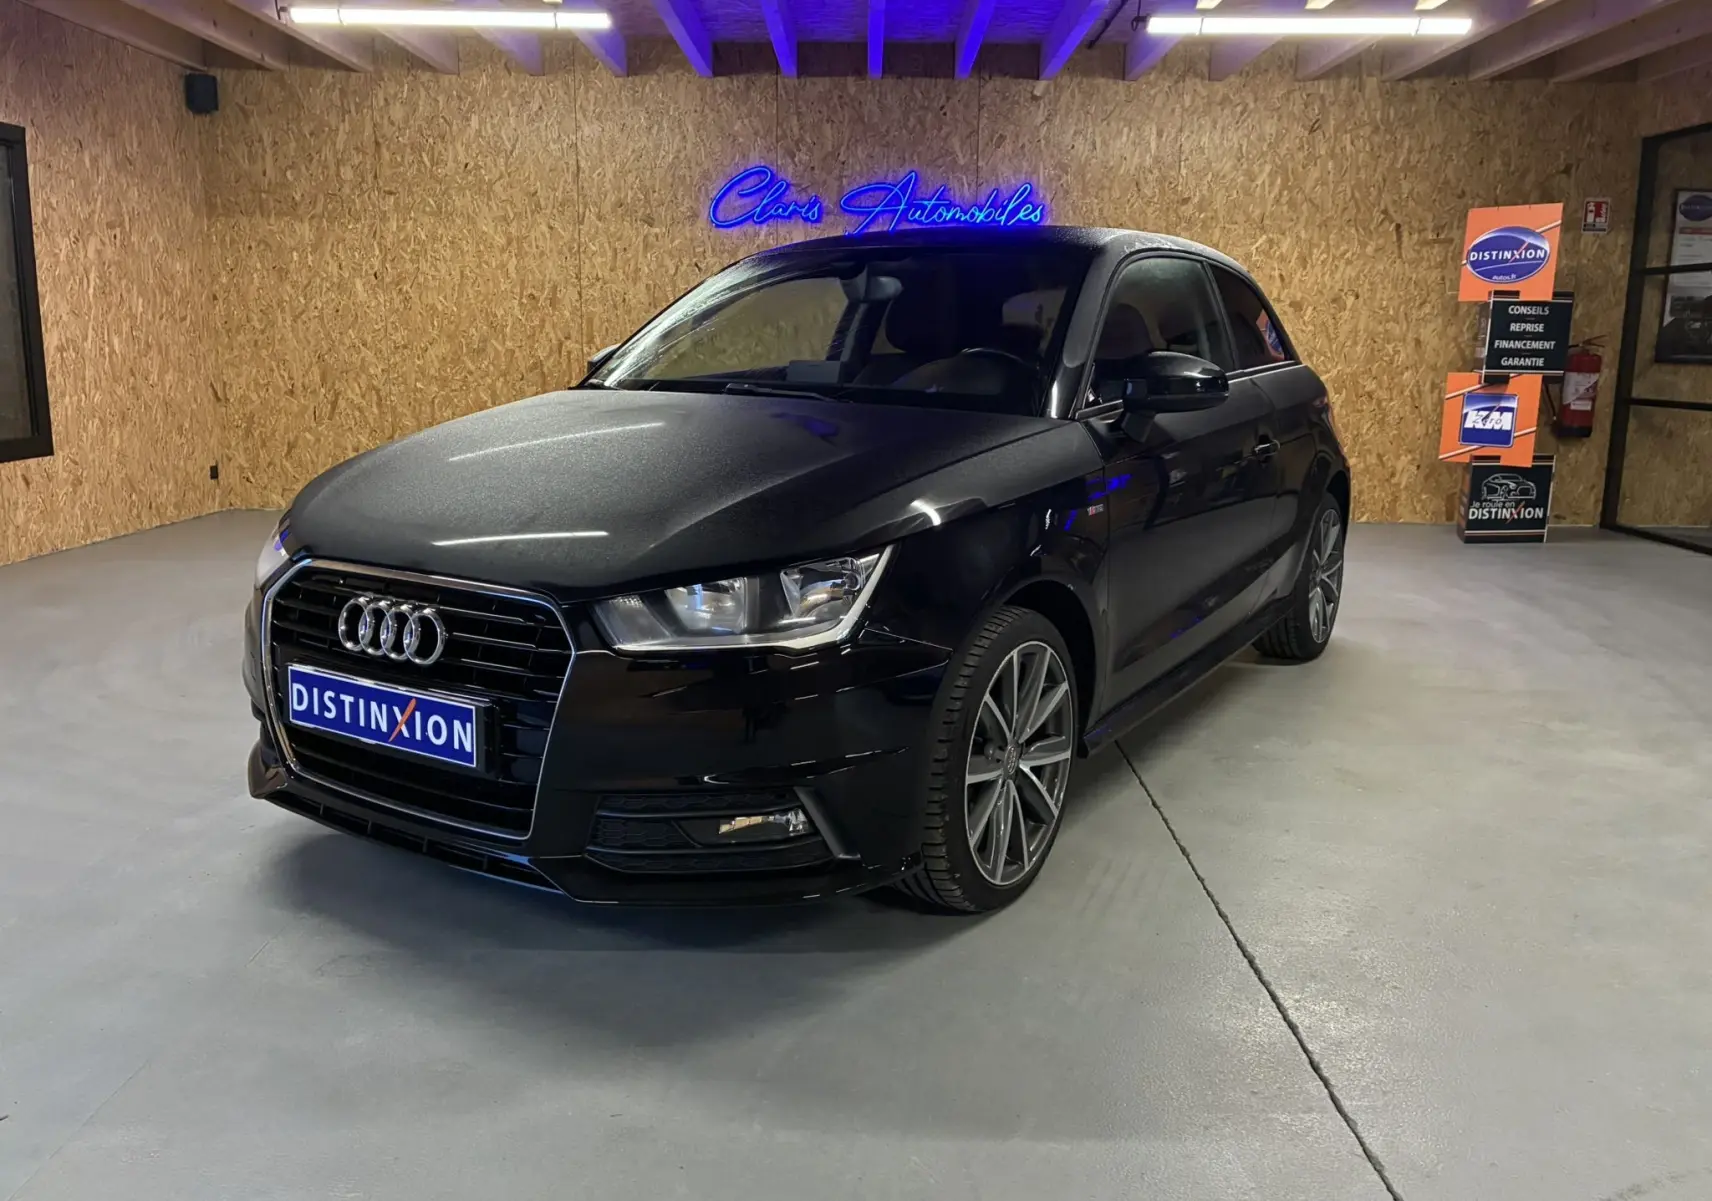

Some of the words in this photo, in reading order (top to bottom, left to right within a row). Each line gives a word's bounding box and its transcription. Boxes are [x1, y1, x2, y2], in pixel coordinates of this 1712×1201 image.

[709, 165, 820, 226] Claris
[840, 171, 1044, 235] Automobiles
[1470, 248, 1545, 262] DISTINXION
[1508, 305, 1550, 315] CONSEILS
[1509, 323, 1544, 333] REPRISE
[1494, 340, 1556, 350] FINANCEMENT
[1501, 357, 1545, 367] GARANTIE
[1482, 500, 1504, 508] roule
[1468, 507, 1544, 520] DISTINXION
[292, 682, 472, 753] DISTINXION
